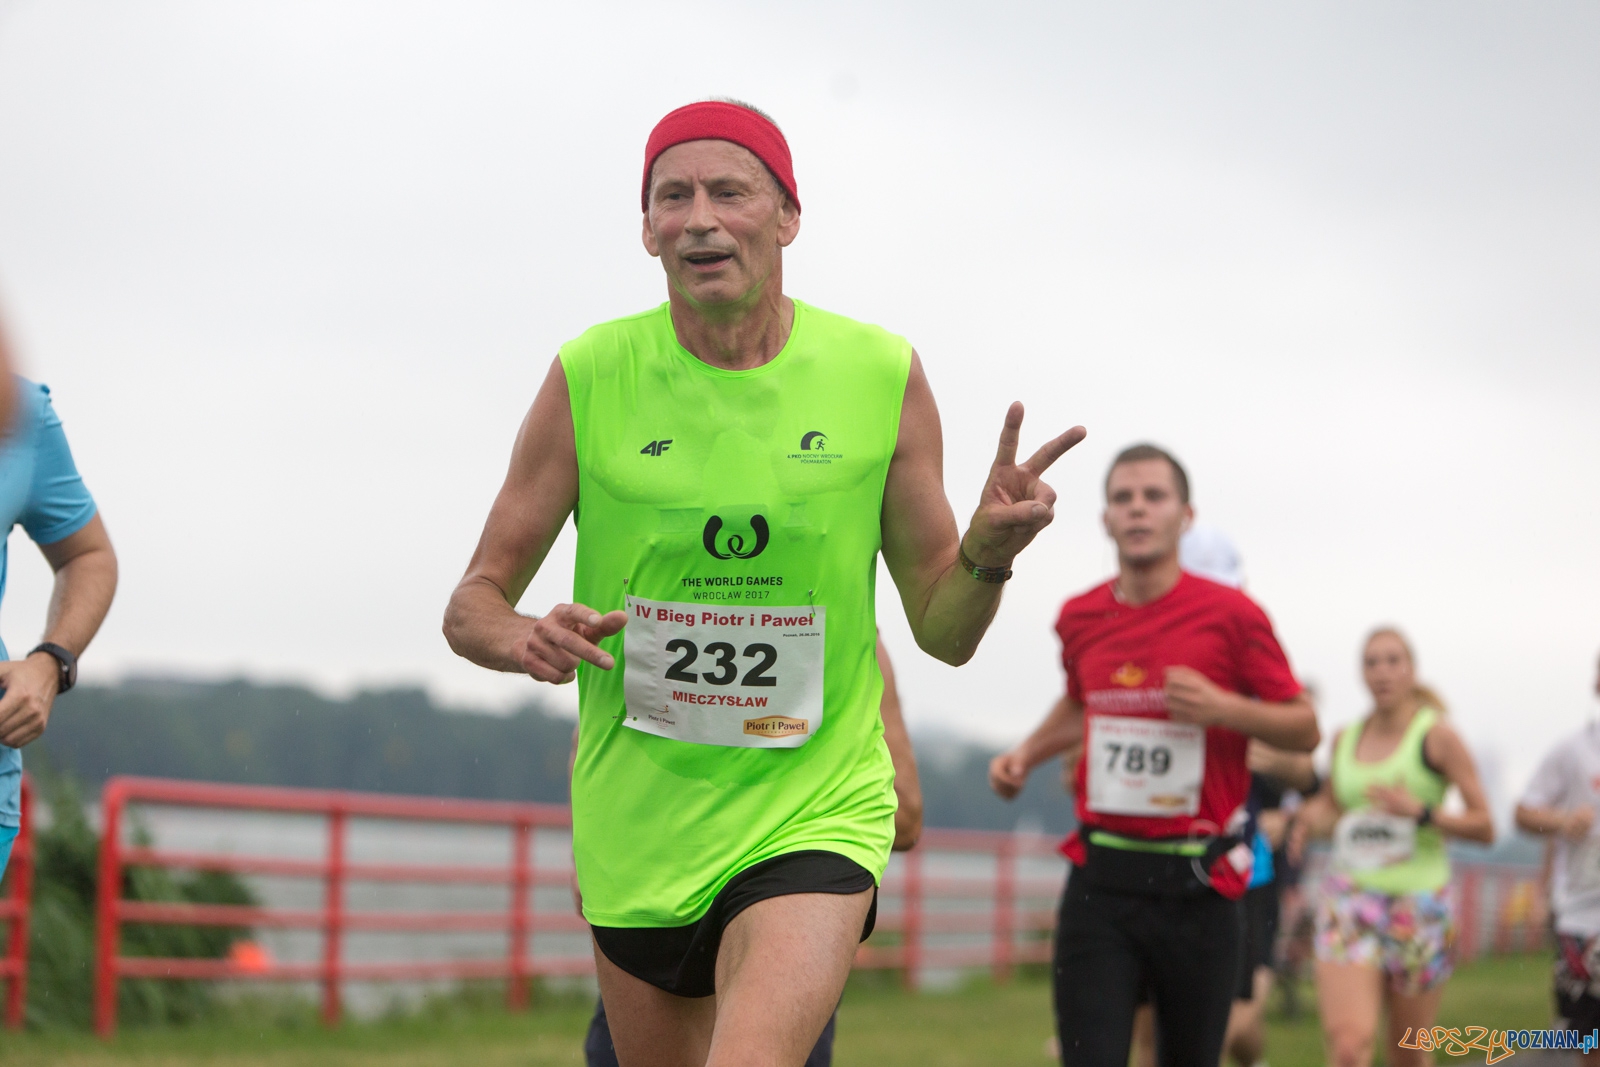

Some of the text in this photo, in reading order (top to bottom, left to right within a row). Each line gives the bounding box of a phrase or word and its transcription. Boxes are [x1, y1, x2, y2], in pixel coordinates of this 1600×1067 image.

[640, 439, 673, 456] 4F
[682, 576, 783, 587] THE WORLD GAMES
[693, 591, 769, 600] WROCŁAW 2017
[636, 604, 813, 627] IV Bieg Piotr i Paweł
[664, 638, 777, 687] 232
[672, 691, 768, 707] MIECZYSŁAW
[746, 722, 805, 730] Piotr i Paweł
[1105, 744, 1170, 775] 789
